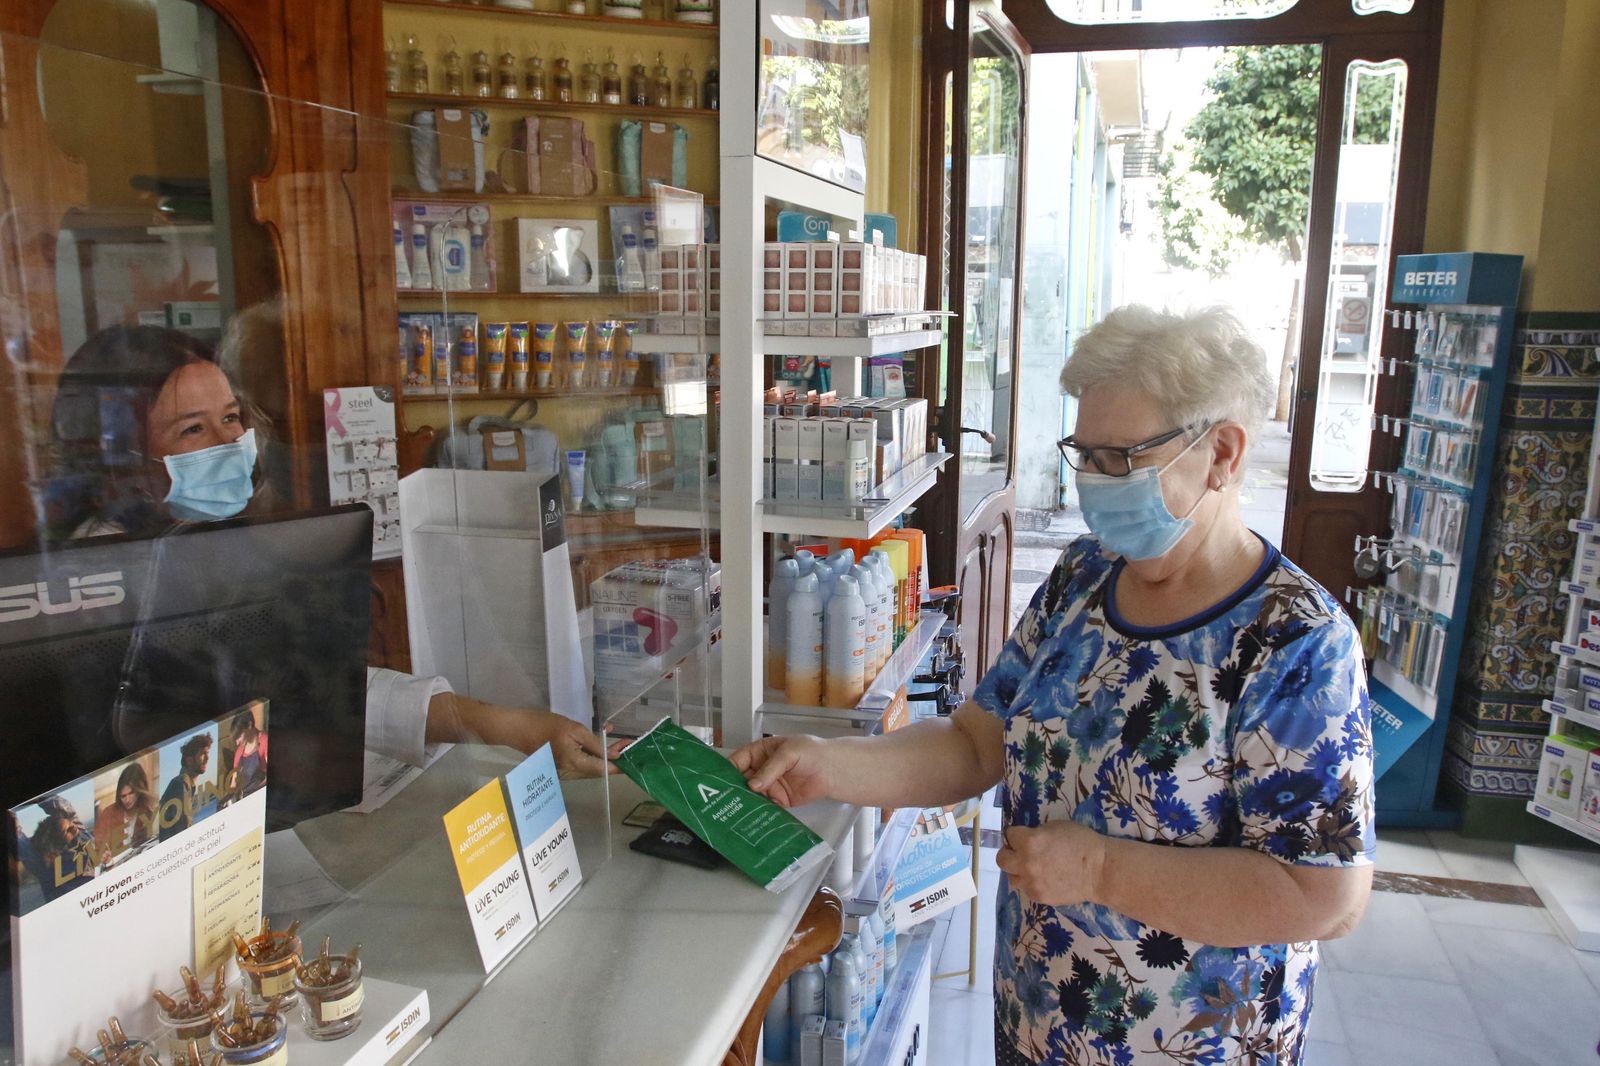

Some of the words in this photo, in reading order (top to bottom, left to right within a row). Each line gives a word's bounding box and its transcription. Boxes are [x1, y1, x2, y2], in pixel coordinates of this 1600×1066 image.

[1404, 271, 1458, 286] BETER
[348, 397, 373, 409] steel
[522, 777, 554, 808] HIDRATANTE
[526, 773, 546, 793] RUTINA
[139, 767, 243, 839] YOUNG
[727, 802, 744, 818] cuida
[459, 812, 506, 855] ANTIOXIDANTE
[466, 811, 492, 835] RUTINA
[547, 827, 569, 853] YOUNG
[79, 890, 103, 909] Vivir
[105, 875, 133, 897] joven
[134, 870, 145, 879] es
[184, 839, 196, 851] de
[196, 822, 226, 844] actitud
[87, 898, 115, 919] Verse
[117, 882, 144, 904] joven
[145, 877, 156, 886] es
[194, 847, 205, 858] de
[206, 836, 222, 852] piel
[557, 867, 570, 884] ISDIN
[492, 869, 520, 897] YOUNG
[926, 887, 949, 905] ISDIN
[505, 912, 521, 931] ISDIN
[400, 1007, 421, 1031] ISDIN
